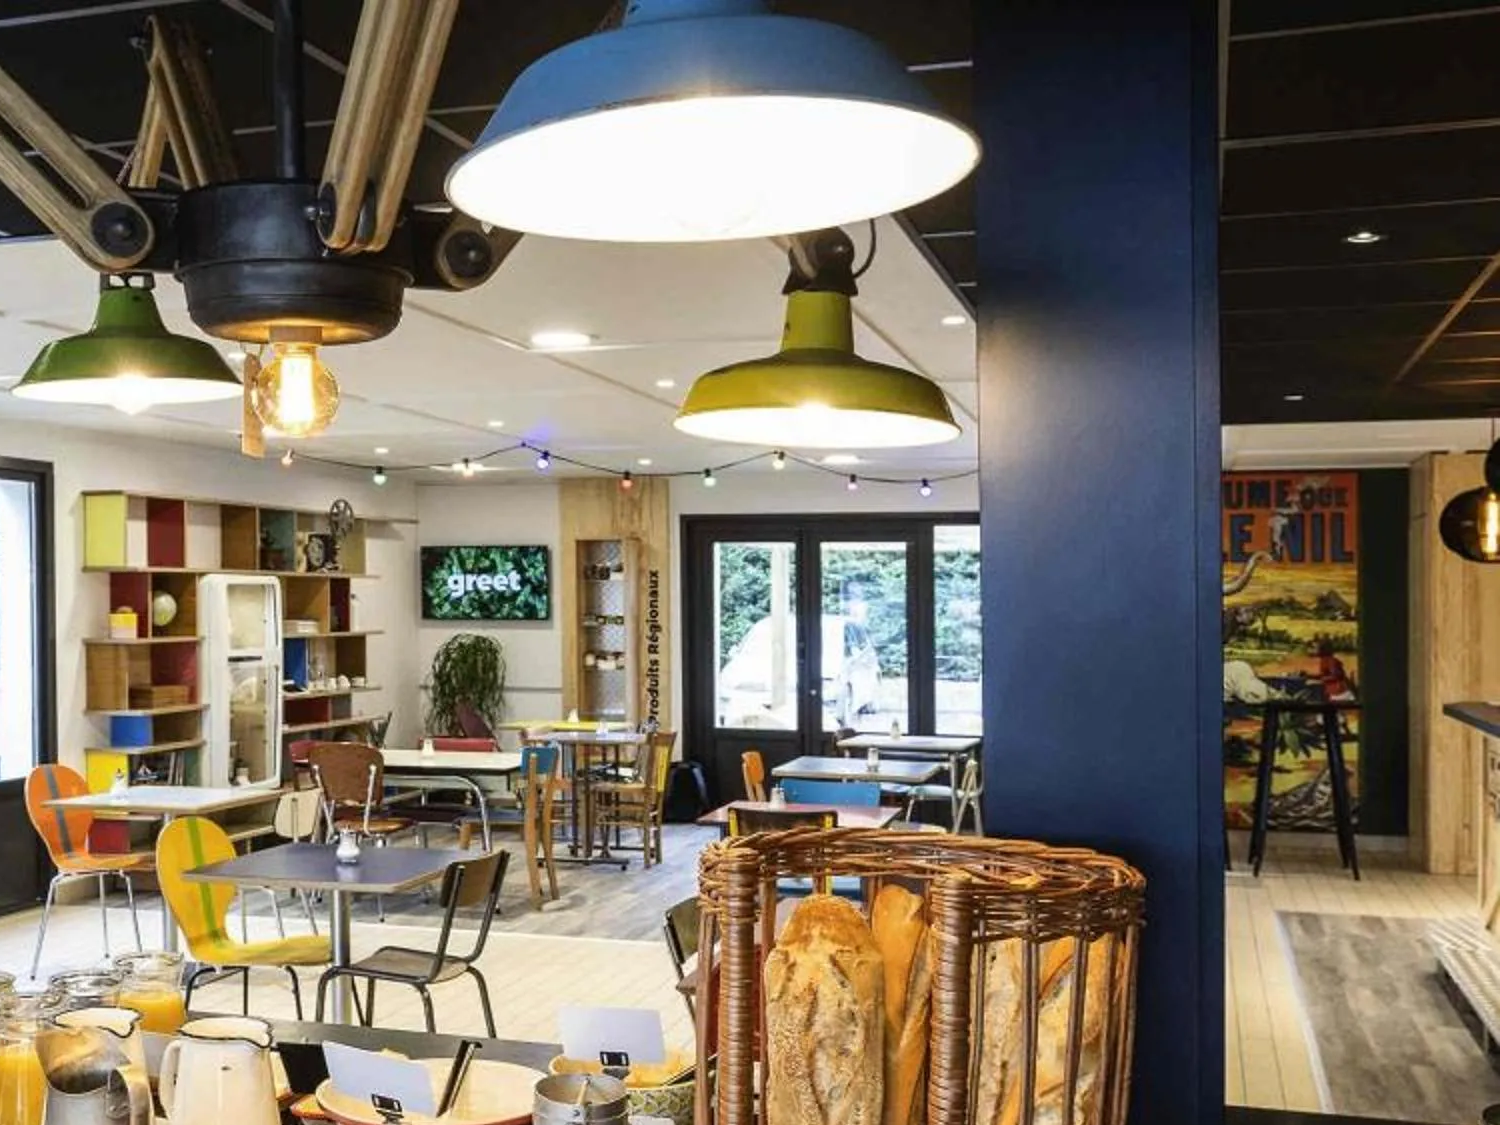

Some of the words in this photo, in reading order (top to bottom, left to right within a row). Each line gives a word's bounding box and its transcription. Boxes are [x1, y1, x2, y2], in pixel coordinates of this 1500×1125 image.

[1221, 513, 1255, 562] E
[447, 569, 521, 597] greet
[646, 570, 662, 655] Régionaux
